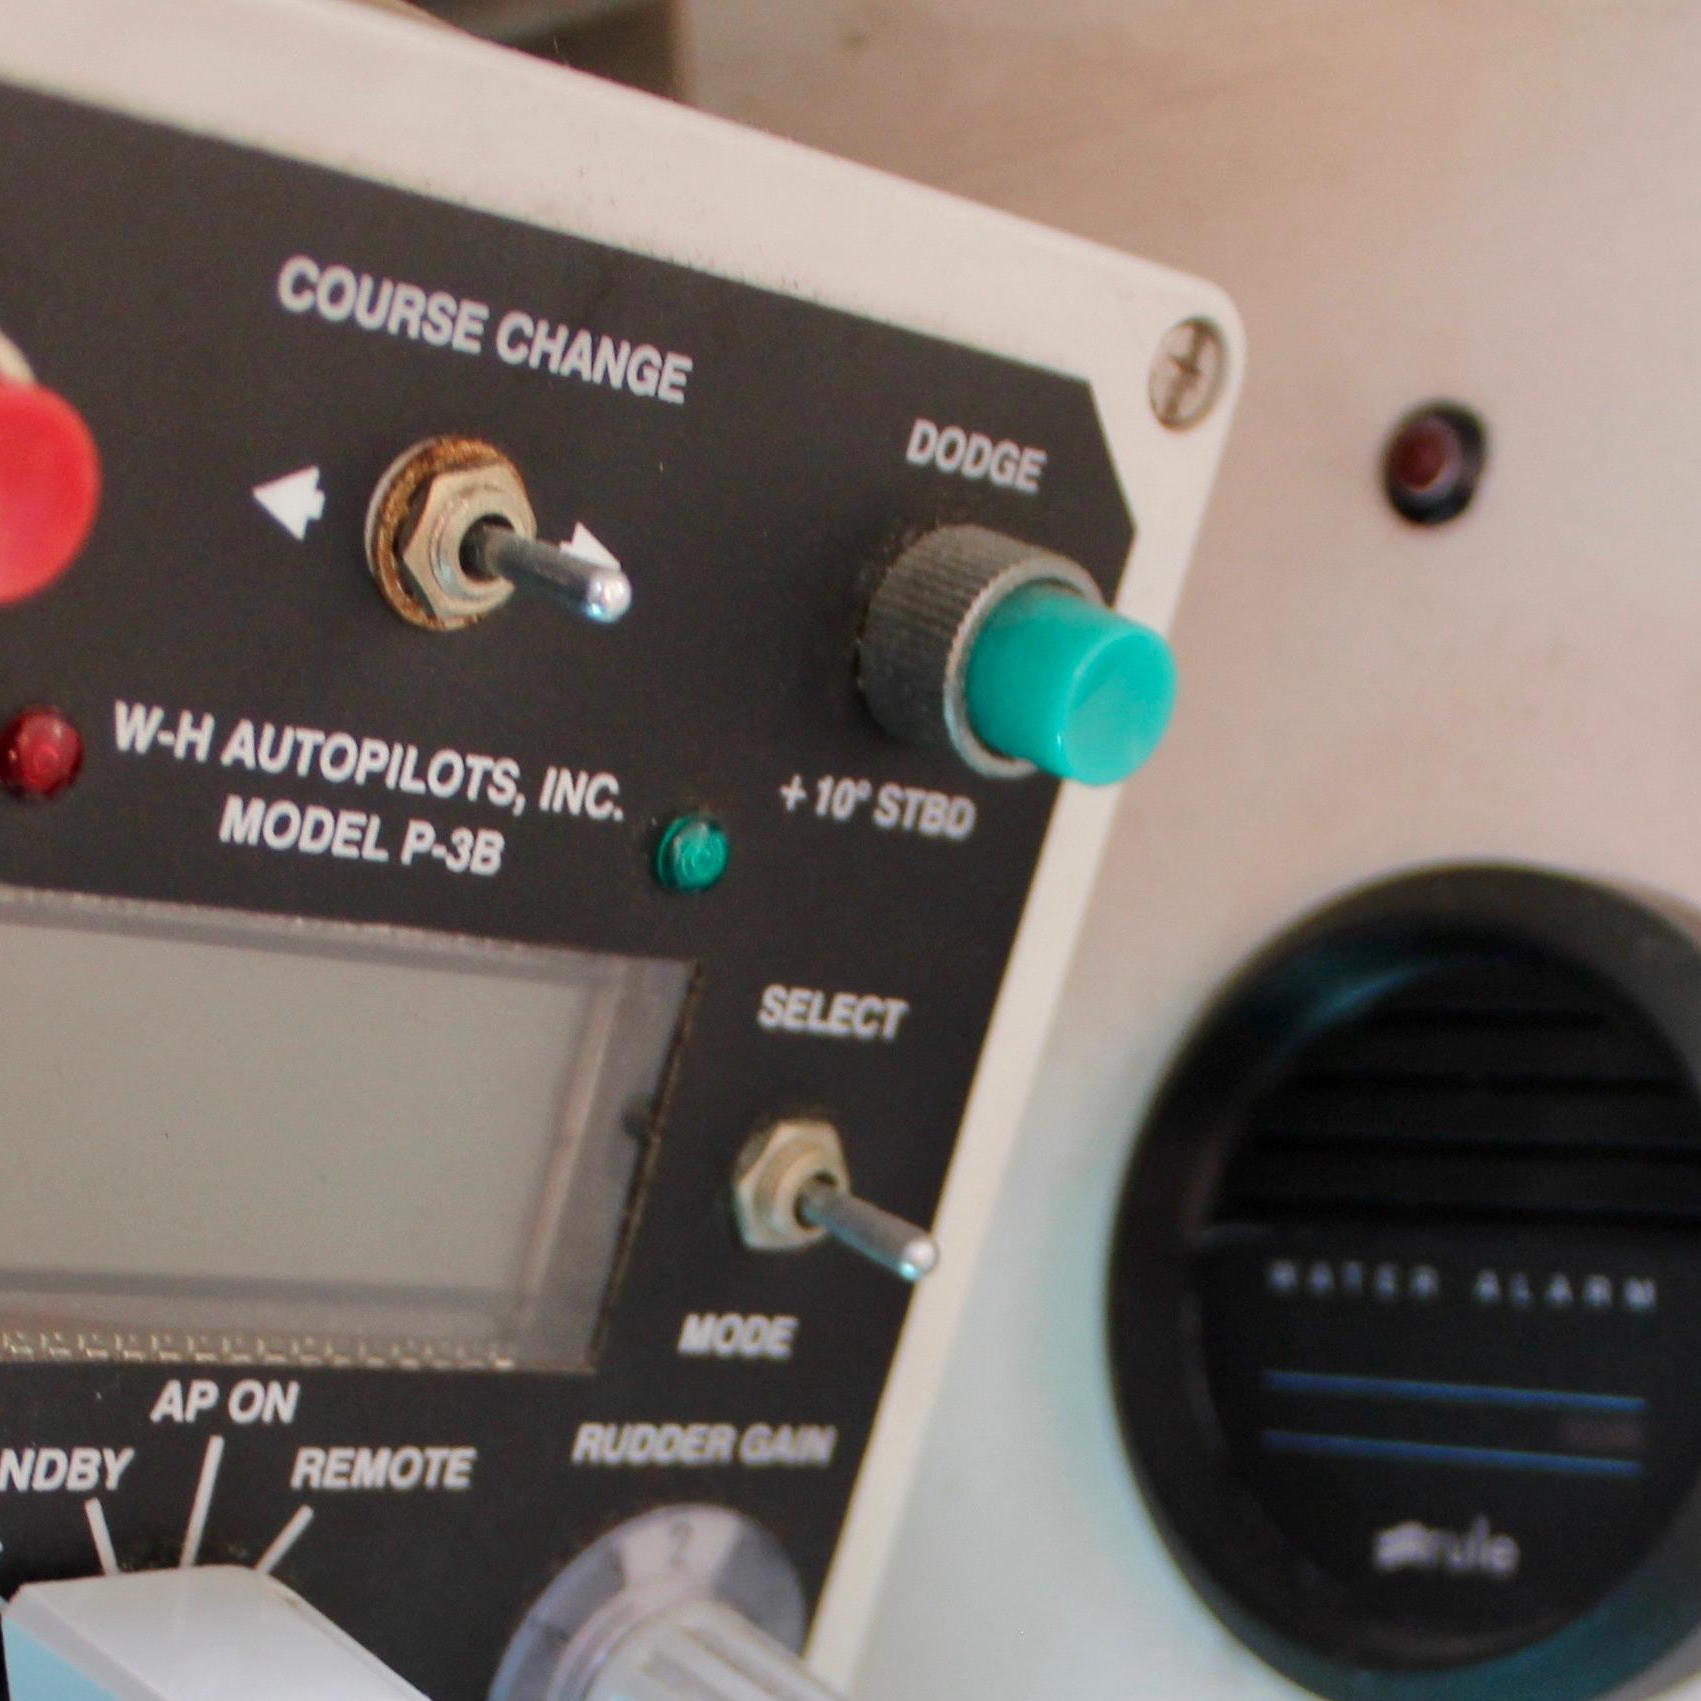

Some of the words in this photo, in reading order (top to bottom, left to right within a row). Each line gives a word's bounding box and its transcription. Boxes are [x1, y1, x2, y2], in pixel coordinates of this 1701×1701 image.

[277, 255, 490, 355] COURSE
[495, 311, 693, 405] CHANGE
[905, 418, 1047, 494] DODGE
[114, 701, 215, 762] W-H
[220, 718, 526, 817] AUTOPILOTS,
[539, 766, 625, 822] INC.
[219, 795, 391, 863] MODEL
[399, 819, 506, 876] P-3B
[872, 783, 976, 840] STBD
[757, 984, 909, 1039] SELECT
[1269, 1260, 1439, 1298] WATER
[1476, 1272, 1657, 1310] ALARM
[677, 1312, 798, 1359] MODE
[149, 1379, 220, 1423] AP
[227, 1379, 300, 1424] ON
[290, 1446, 477, 1490] REMOTE
[571, 1422, 736, 1466] RUDDER
[738, 1422, 837, 1466] GAIN
